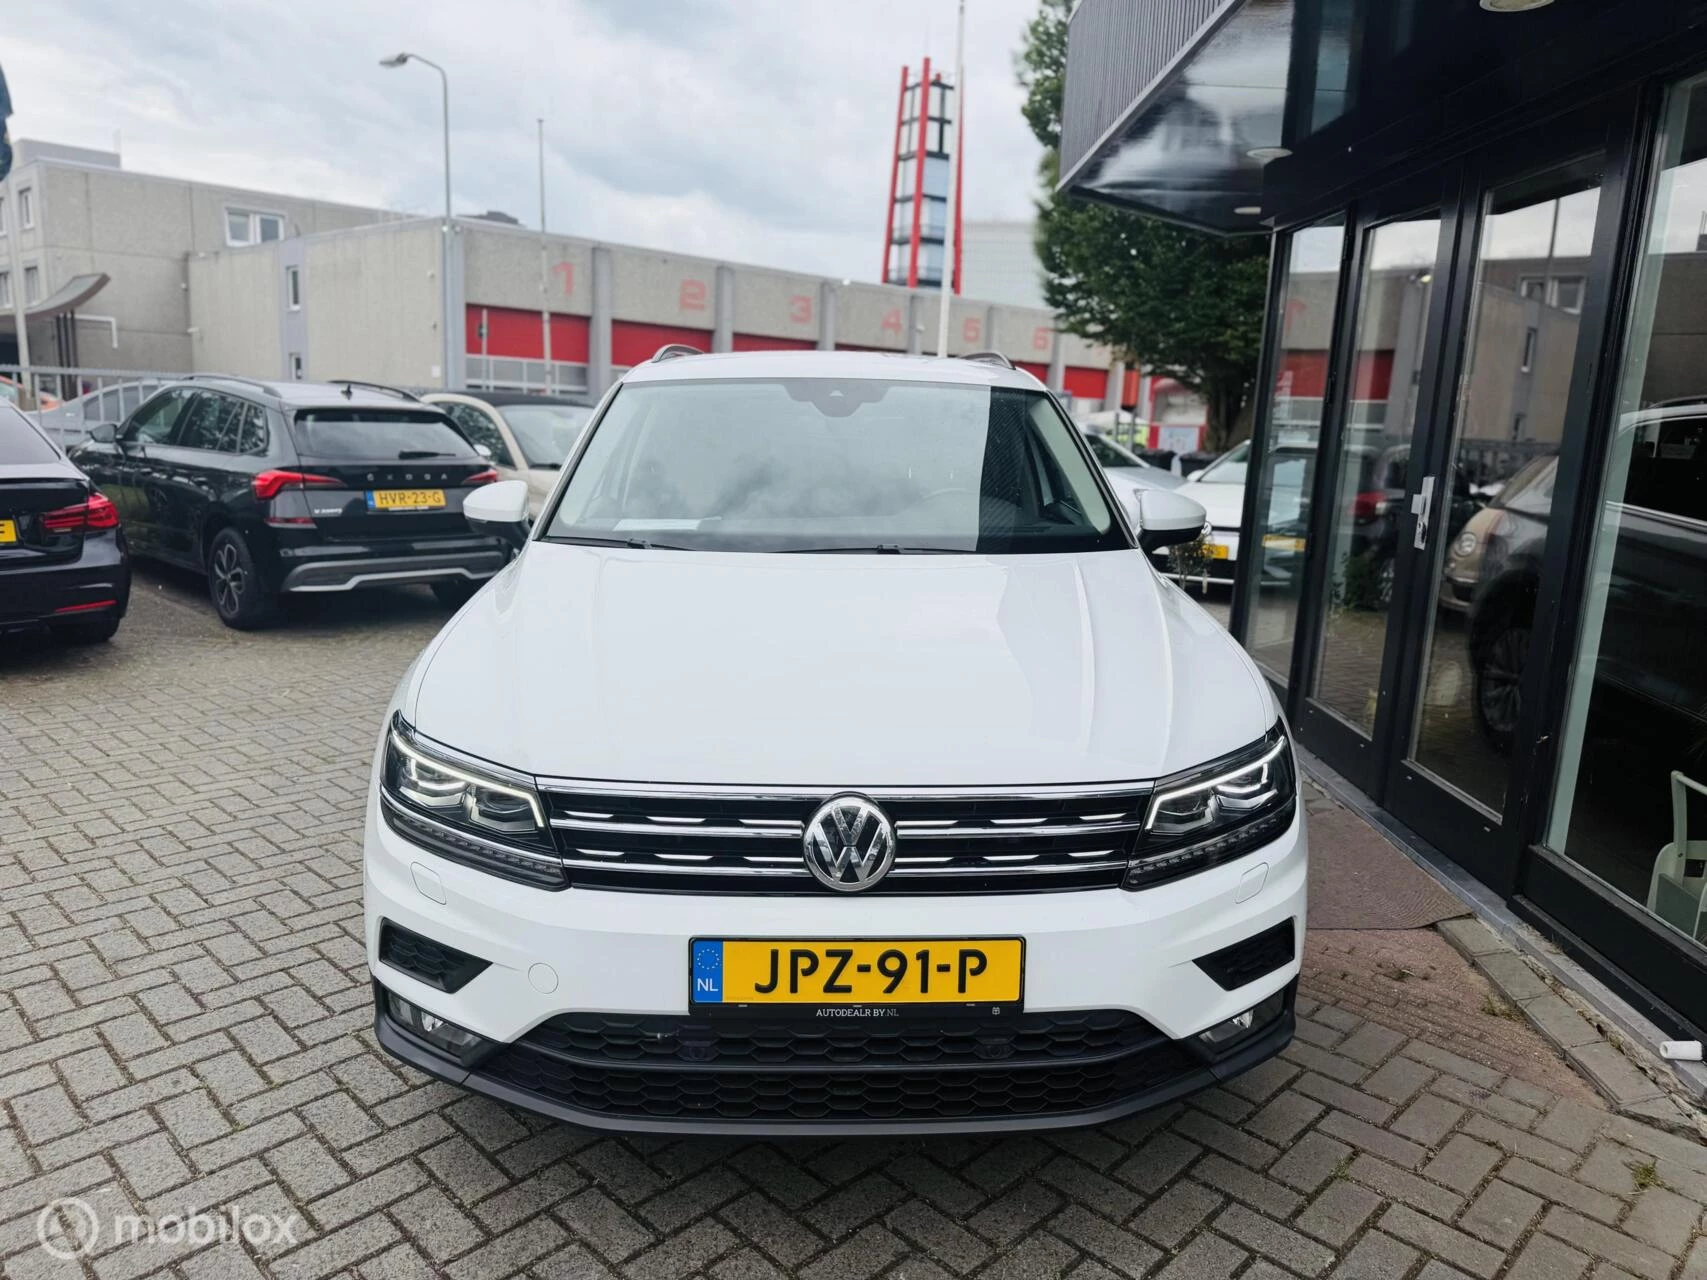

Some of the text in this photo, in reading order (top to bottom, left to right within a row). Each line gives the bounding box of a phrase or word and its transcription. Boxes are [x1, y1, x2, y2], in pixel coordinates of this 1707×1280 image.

[550, 260, 574, 297] 1
[679, 277, 706, 312] 2
[789, 294, 813, 324] 3
[881, 306, 902, 335] 4
[379, 491, 442, 505] HVR-23-G
[697, 948, 989, 994] NL JPZ-91-P
[816, 1008, 872, 1017] AUTODEALR
